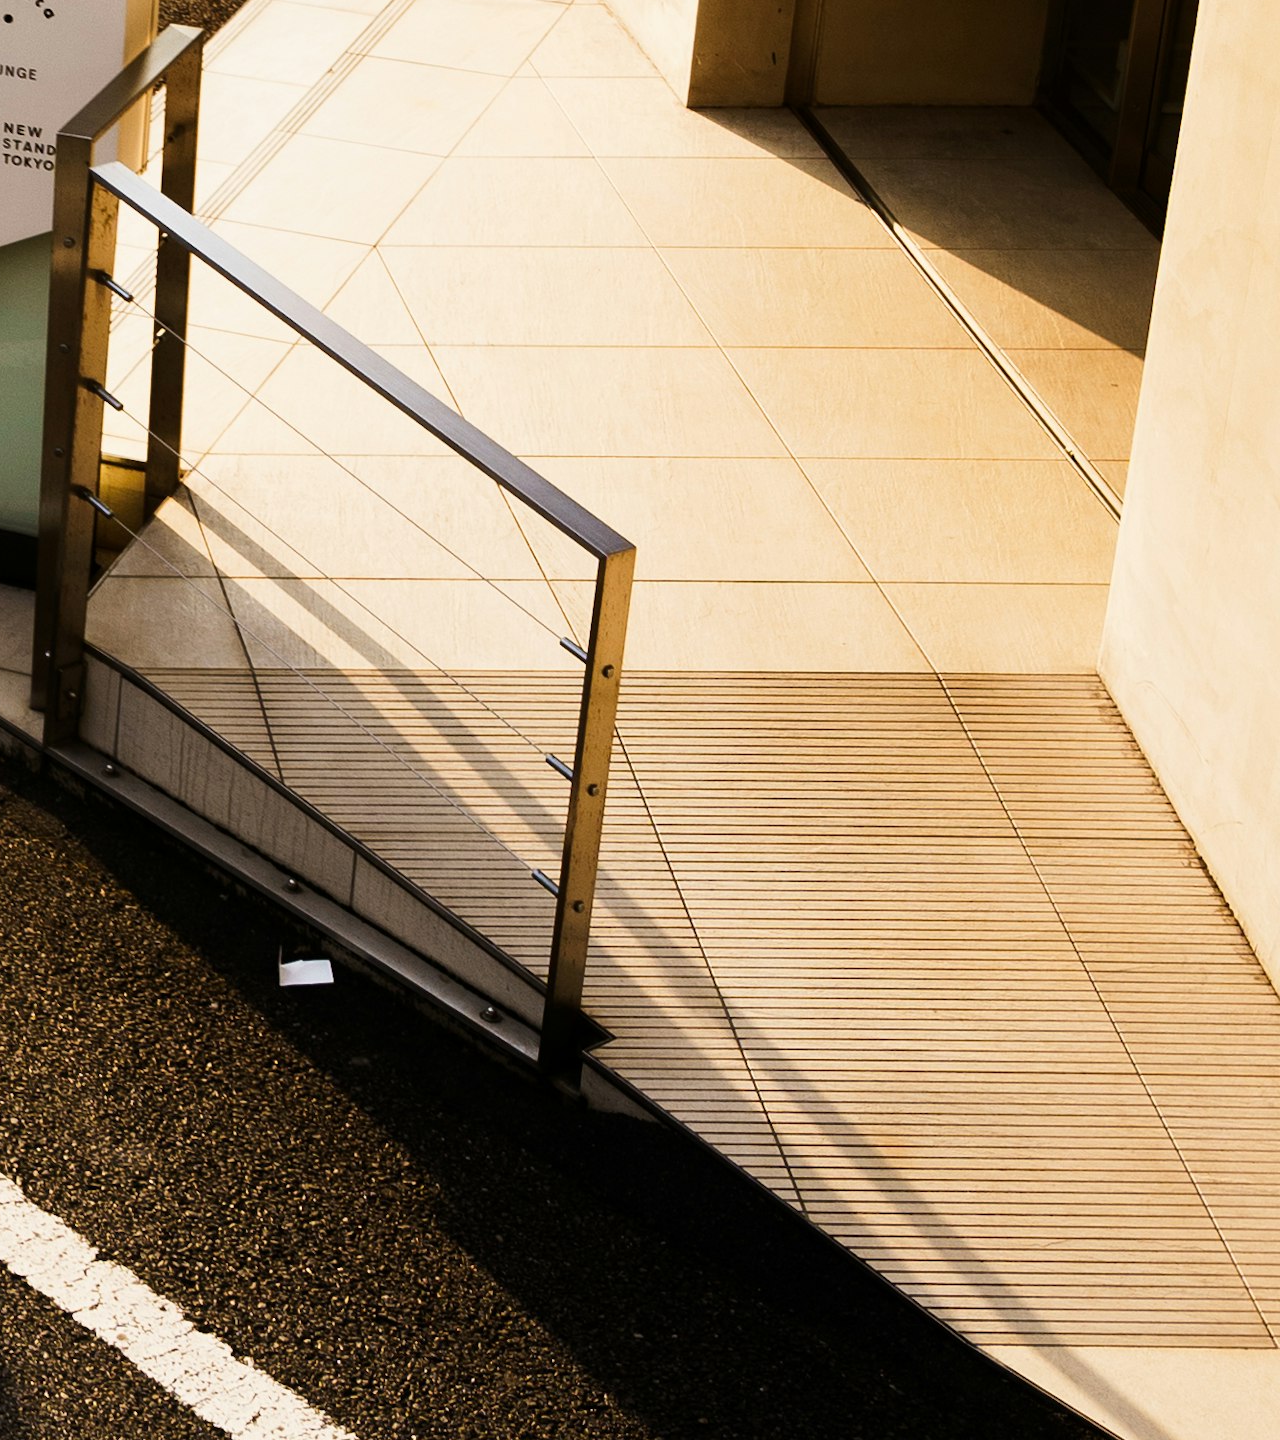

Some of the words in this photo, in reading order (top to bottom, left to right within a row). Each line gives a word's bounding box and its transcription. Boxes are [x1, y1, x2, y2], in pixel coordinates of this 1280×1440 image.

[3, 121, 43, 138] NEW
[2, 138, 57, 155] STAND
[3, 153, 55, 172] TOKYO
